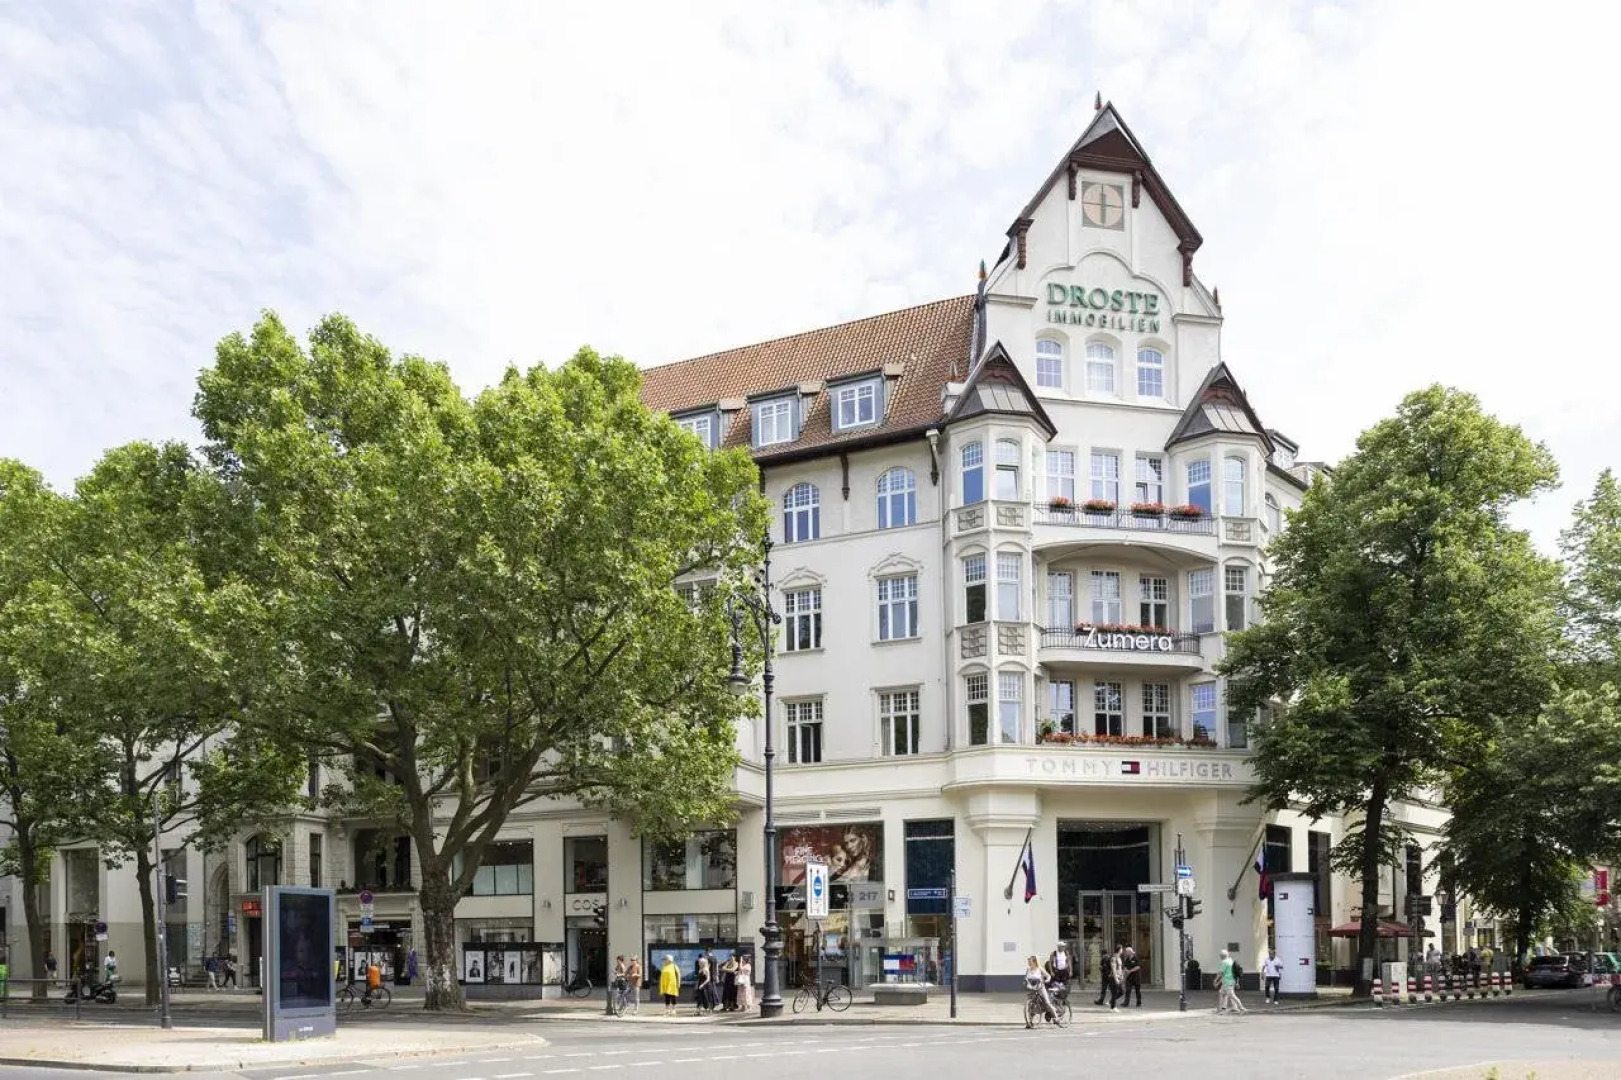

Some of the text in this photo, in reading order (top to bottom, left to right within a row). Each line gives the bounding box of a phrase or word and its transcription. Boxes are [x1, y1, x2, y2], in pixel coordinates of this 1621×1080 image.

[1046, 282, 1160, 316] DROSTE
[1047, 308, 1160, 334] IMMOBILIEN
[1083, 627, 1172, 652] Zumera
[1025, 758, 1232, 779] TOMMY HILFIGER
[572, 899, 600, 911] COS
[859, 891, 879, 901] 217
